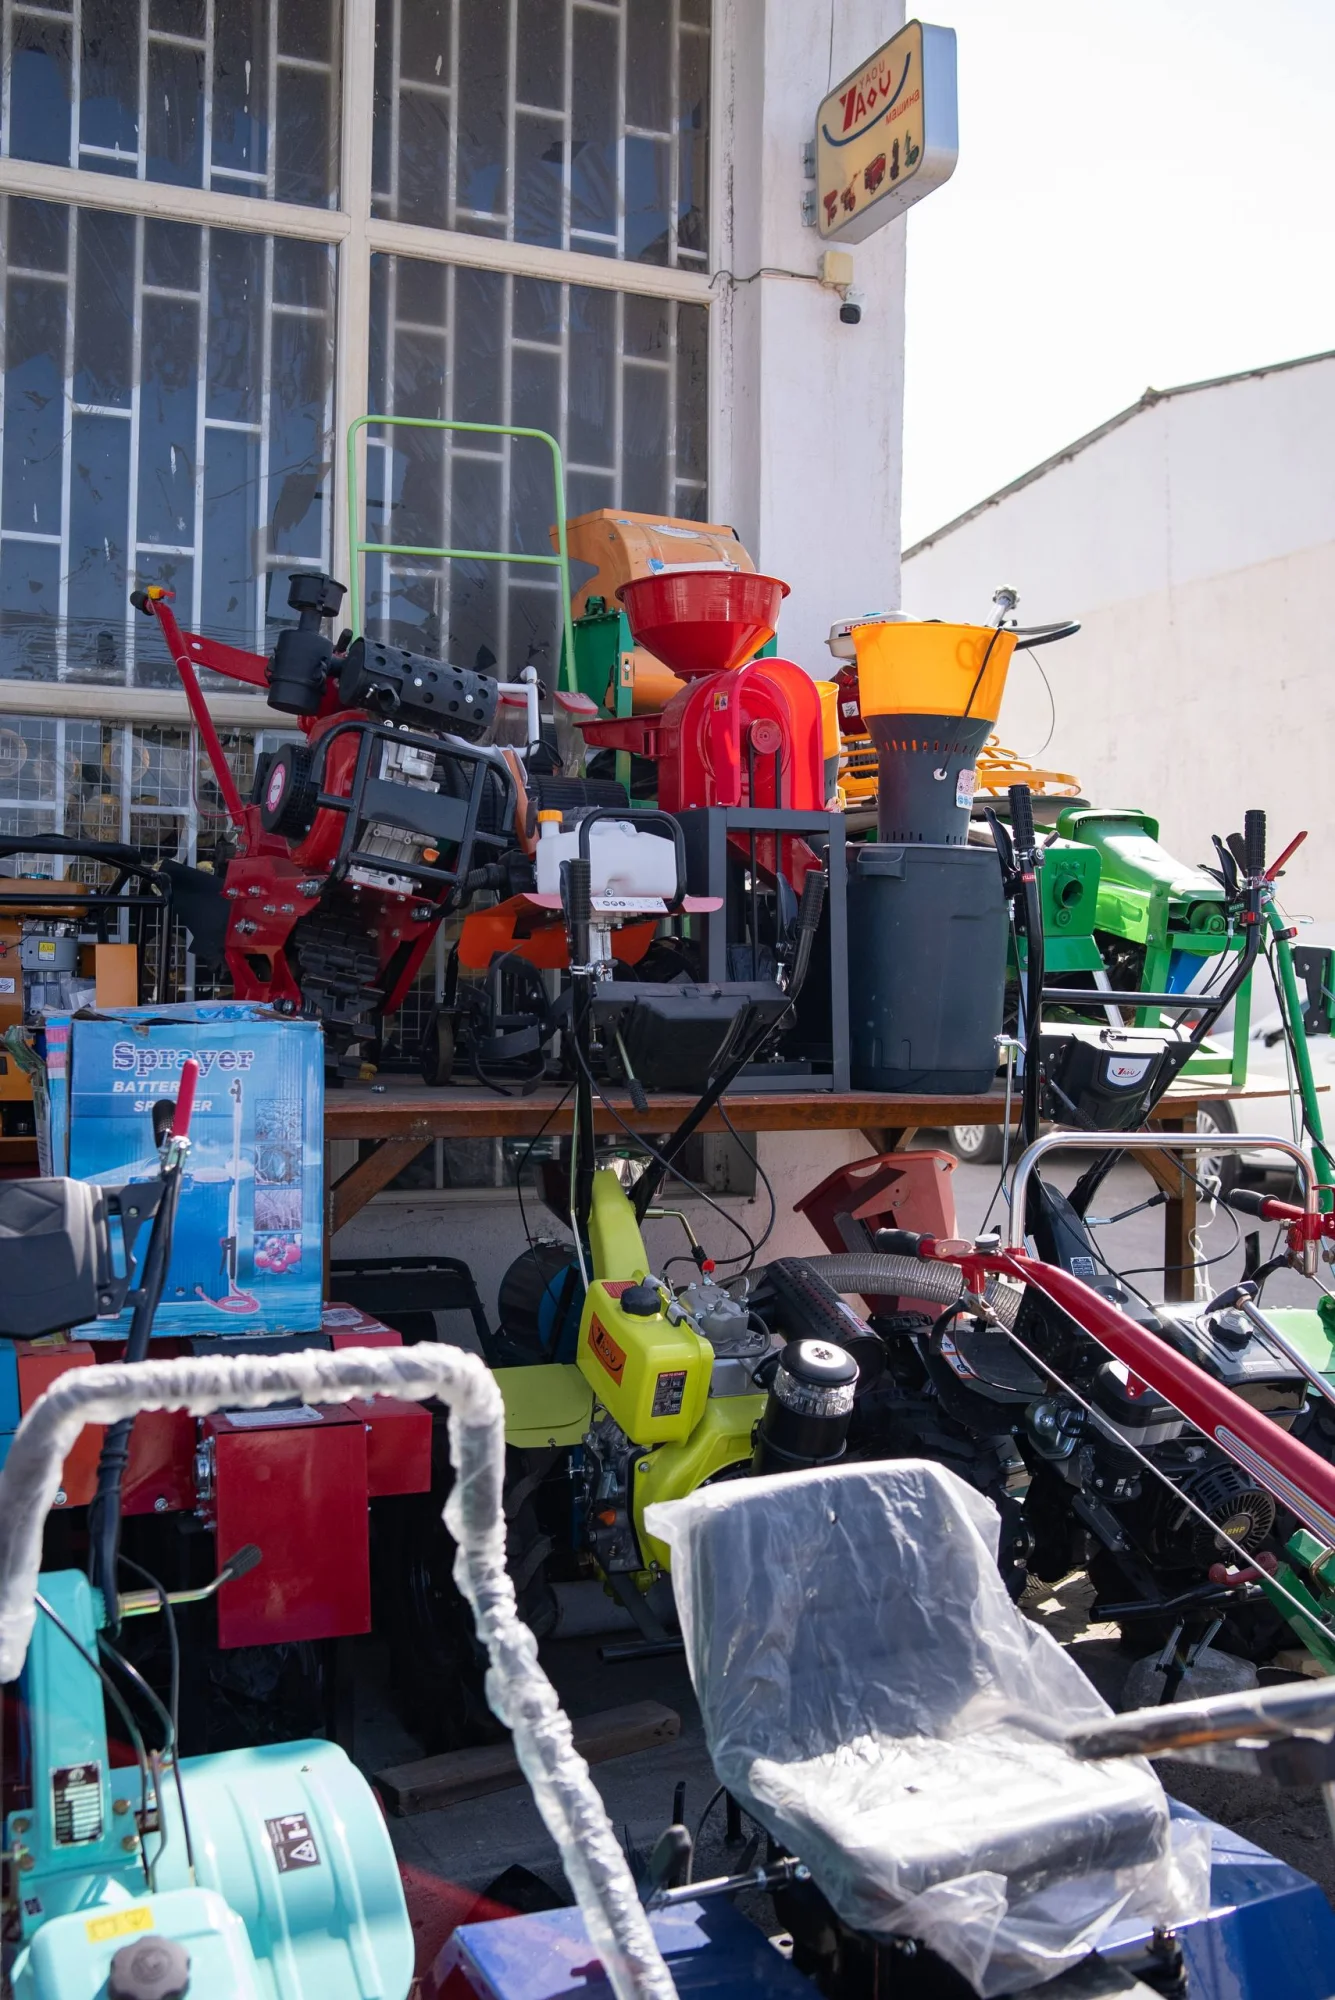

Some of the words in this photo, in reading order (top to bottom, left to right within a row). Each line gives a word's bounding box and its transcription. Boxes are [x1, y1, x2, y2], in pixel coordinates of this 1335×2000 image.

[113, 1041, 254, 1077] Sprayer
[113, 1080, 181, 1093] BATTER
[133, 1100, 213, 1112] SPER
